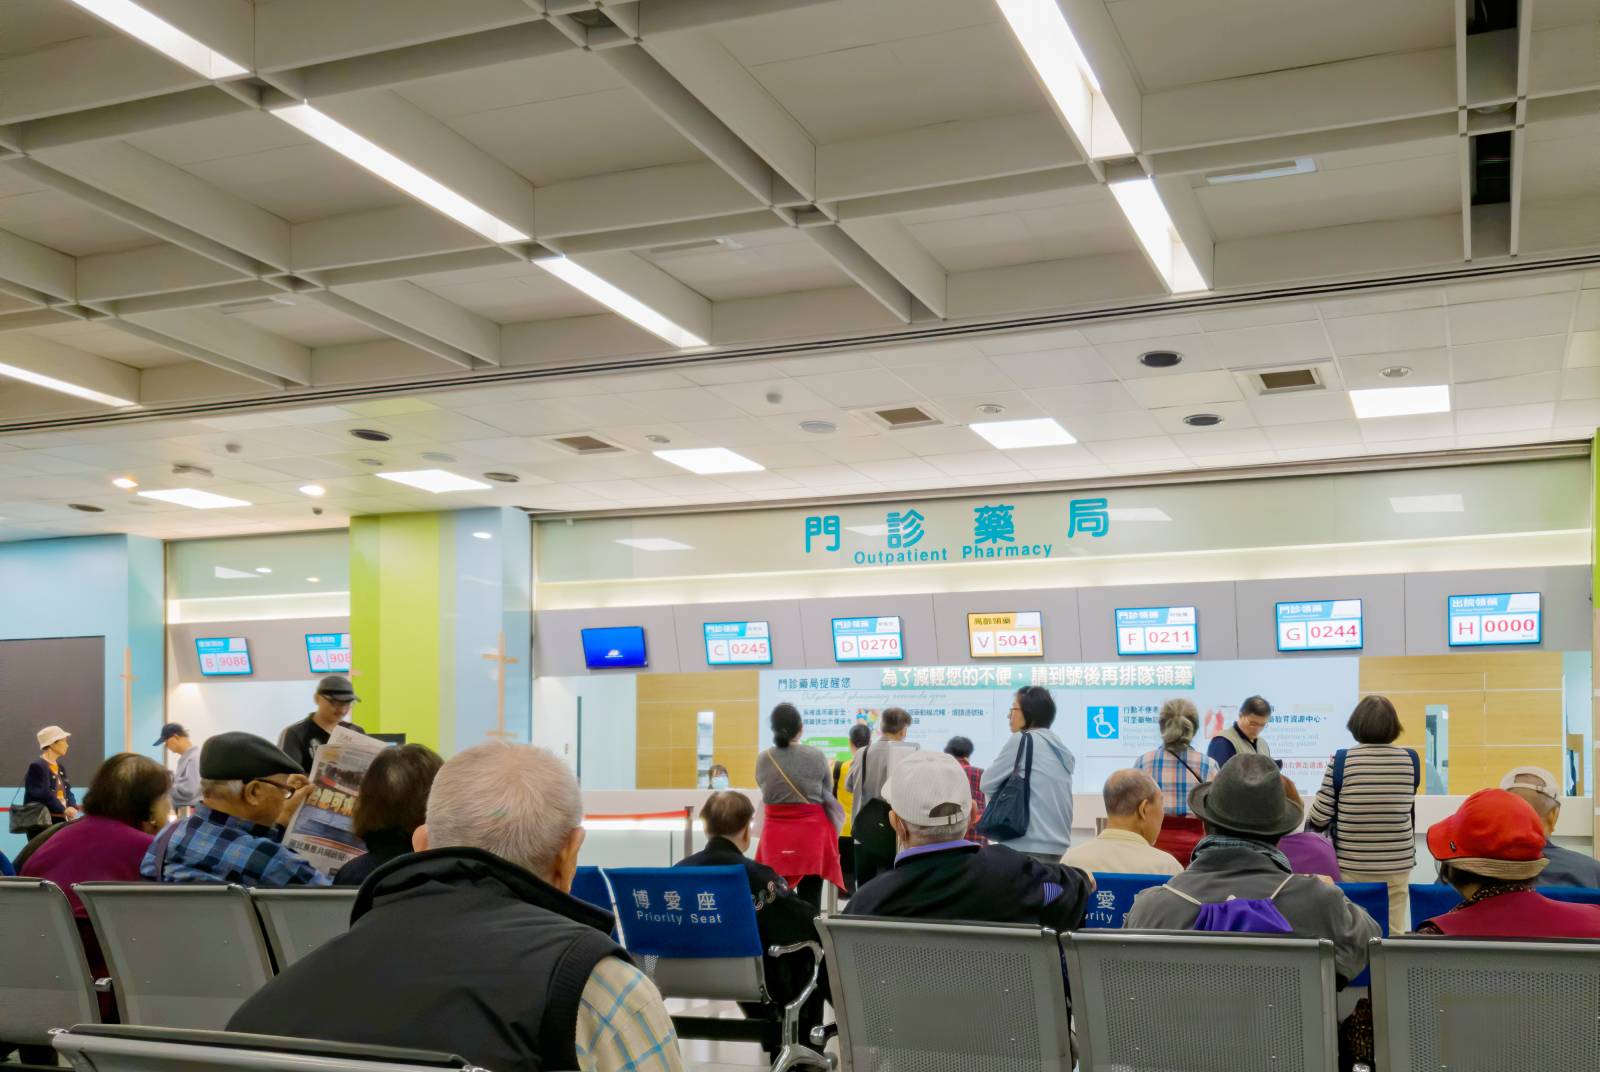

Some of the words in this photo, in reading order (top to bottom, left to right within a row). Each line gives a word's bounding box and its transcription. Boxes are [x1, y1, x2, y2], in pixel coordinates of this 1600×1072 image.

[805, 498, 1110, 553] 門診藥局
[854, 547, 948, 565] Outpatient
[962, 543, 1053, 560] Pharmacy
[1286, 627, 1301, 641] G
[1310, 624, 1358, 639] 0244
[1458, 621, 1474, 635] H
[1484, 618, 1536, 633] 0000
[841, 640, 854, 653] D
[860, 638, 898, 651] 0270
[977, 636, 990, 649] V
[998, 634, 1038, 647] 5041
[1128, 632, 1137, 646] F
[1148, 630, 1190, 643] 0211
[713, 644, 725, 657] C
[731, 642, 768, 655] 0245
[315, 655, 326, 665] A
[632, 888, 719, 911] 博愛座
[636, 910, 682, 926] Priority
[690, 913, 723, 924] Seat
